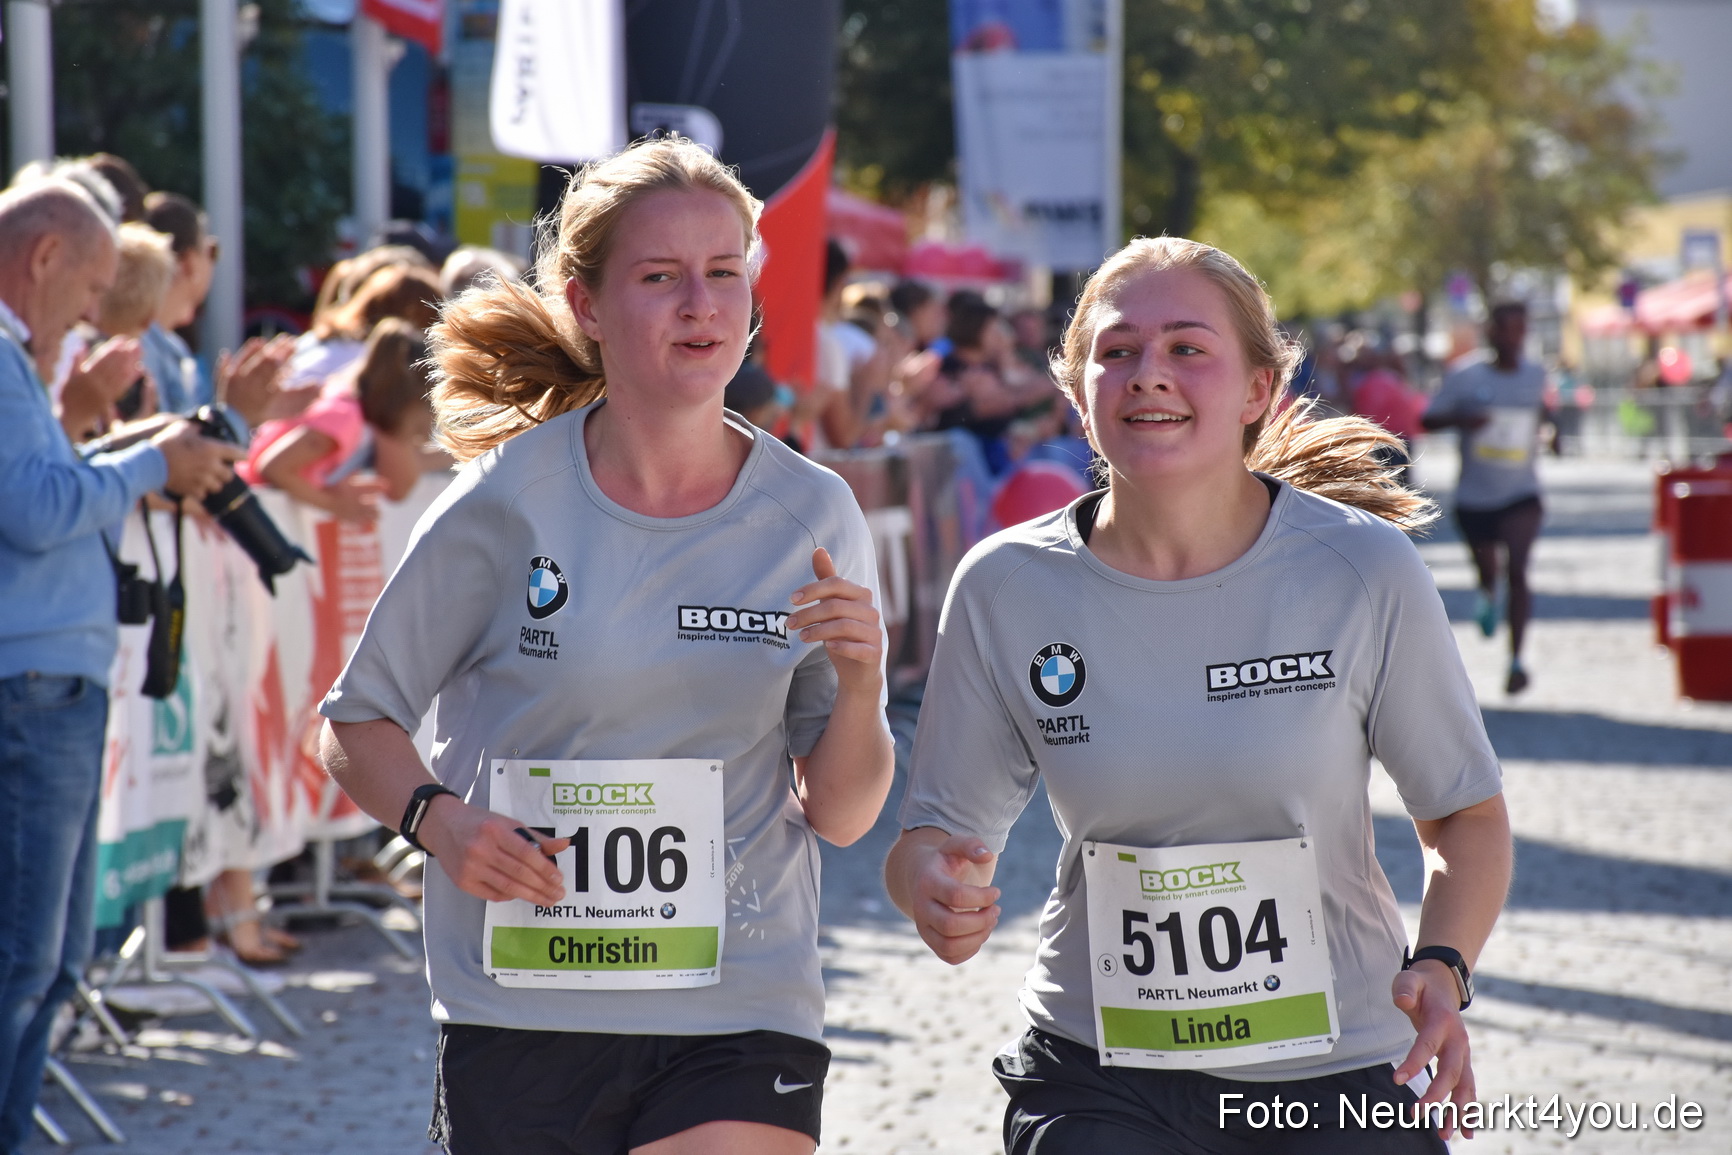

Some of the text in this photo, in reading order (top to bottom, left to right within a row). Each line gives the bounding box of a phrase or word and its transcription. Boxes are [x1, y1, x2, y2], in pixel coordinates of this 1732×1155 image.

[678, 605, 790, 640] BOCK
[520, 626, 559, 647] PARTL
[677, 632, 791, 650] inspired by smart concepts
[518, 642, 558, 660] Neumarkt
[1033, 644, 1081, 668] BMW
[1206, 650, 1336, 692] BOCK
[1207, 681, 1336, 703] inspired by smart concepts
[1036, 715, 1090, 734] PARTL
[552, 782, 655, 806] BOCK
[552, 806, 657, 816] inspired by smart concepts
[726, 862, 745, 888] 2018
[1139, 861, 1245, 893] BOCK
[1141, 884, 1247, 902] inspired by smart concepts
[535, 905, 582, 918] PARTL
[585, 905, 655, 918] Neumarkt
[1122, 898, 1288, 976] 5104
[549, 935, 658, 964] Christin
[1138, 981, 1258, 1001] PARTL Neumarkt
[1171, 1014, 1251, 1045] Linda
